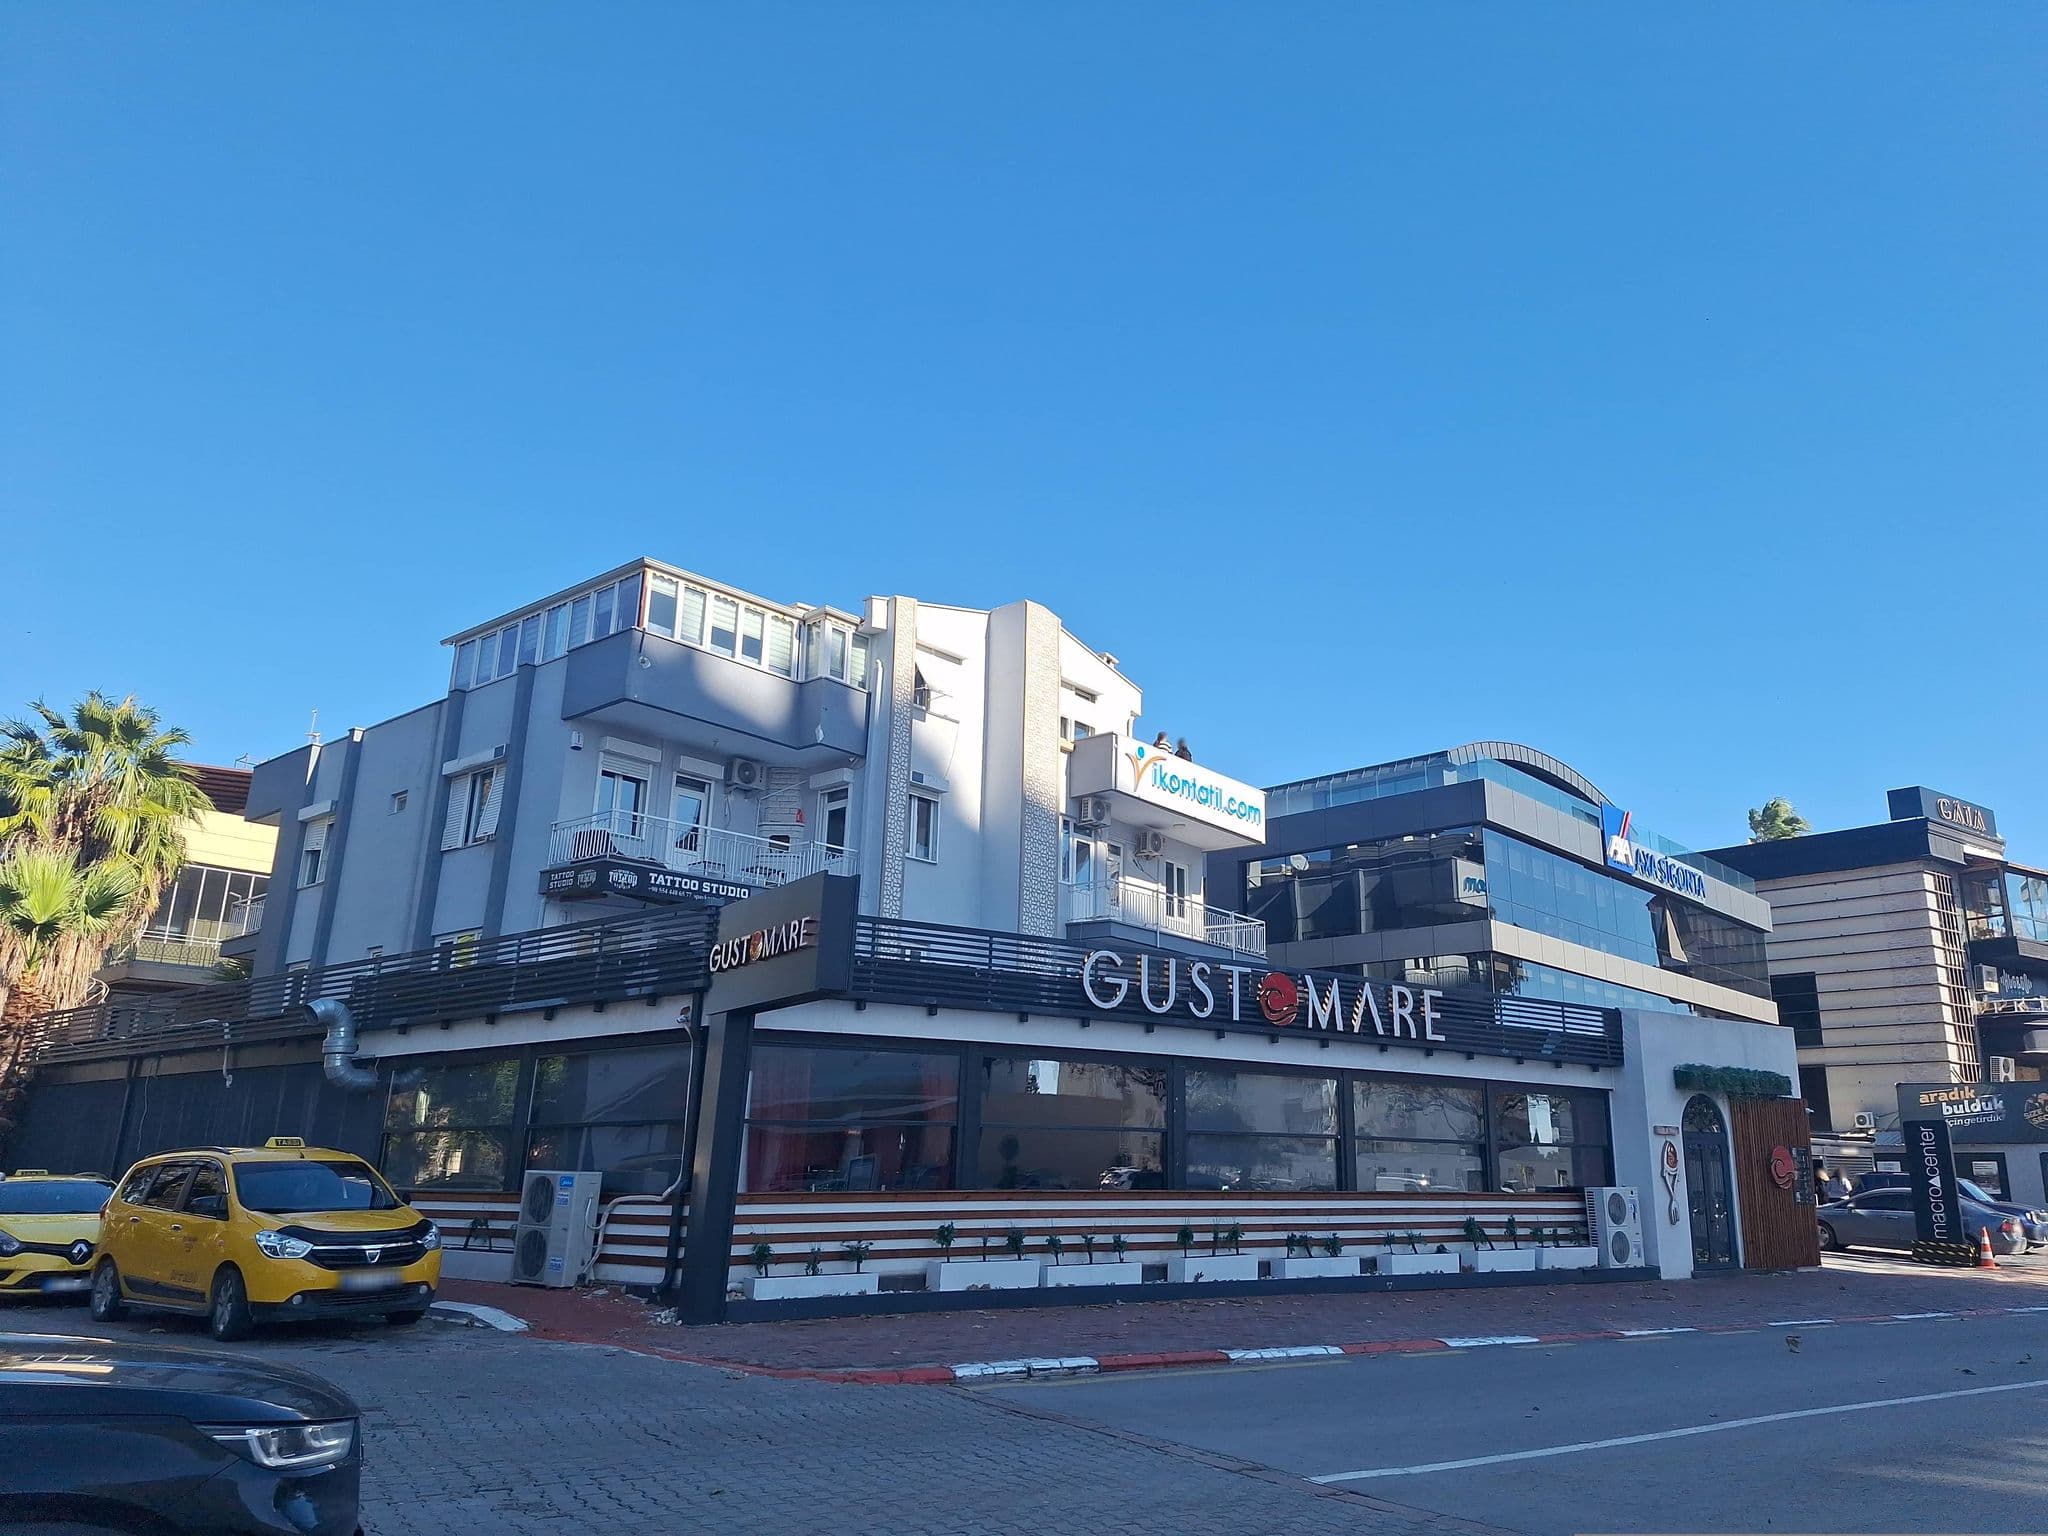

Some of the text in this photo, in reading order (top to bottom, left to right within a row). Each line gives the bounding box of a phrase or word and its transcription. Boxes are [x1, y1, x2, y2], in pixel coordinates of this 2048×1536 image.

[551, 870, 575, 881] TATTOO
[549, 878, 574, 889] STUDIO
[648, 872, 749, 899] TATTOO STUDIO
[1942, 1098, 2004, 1116] bulduk
